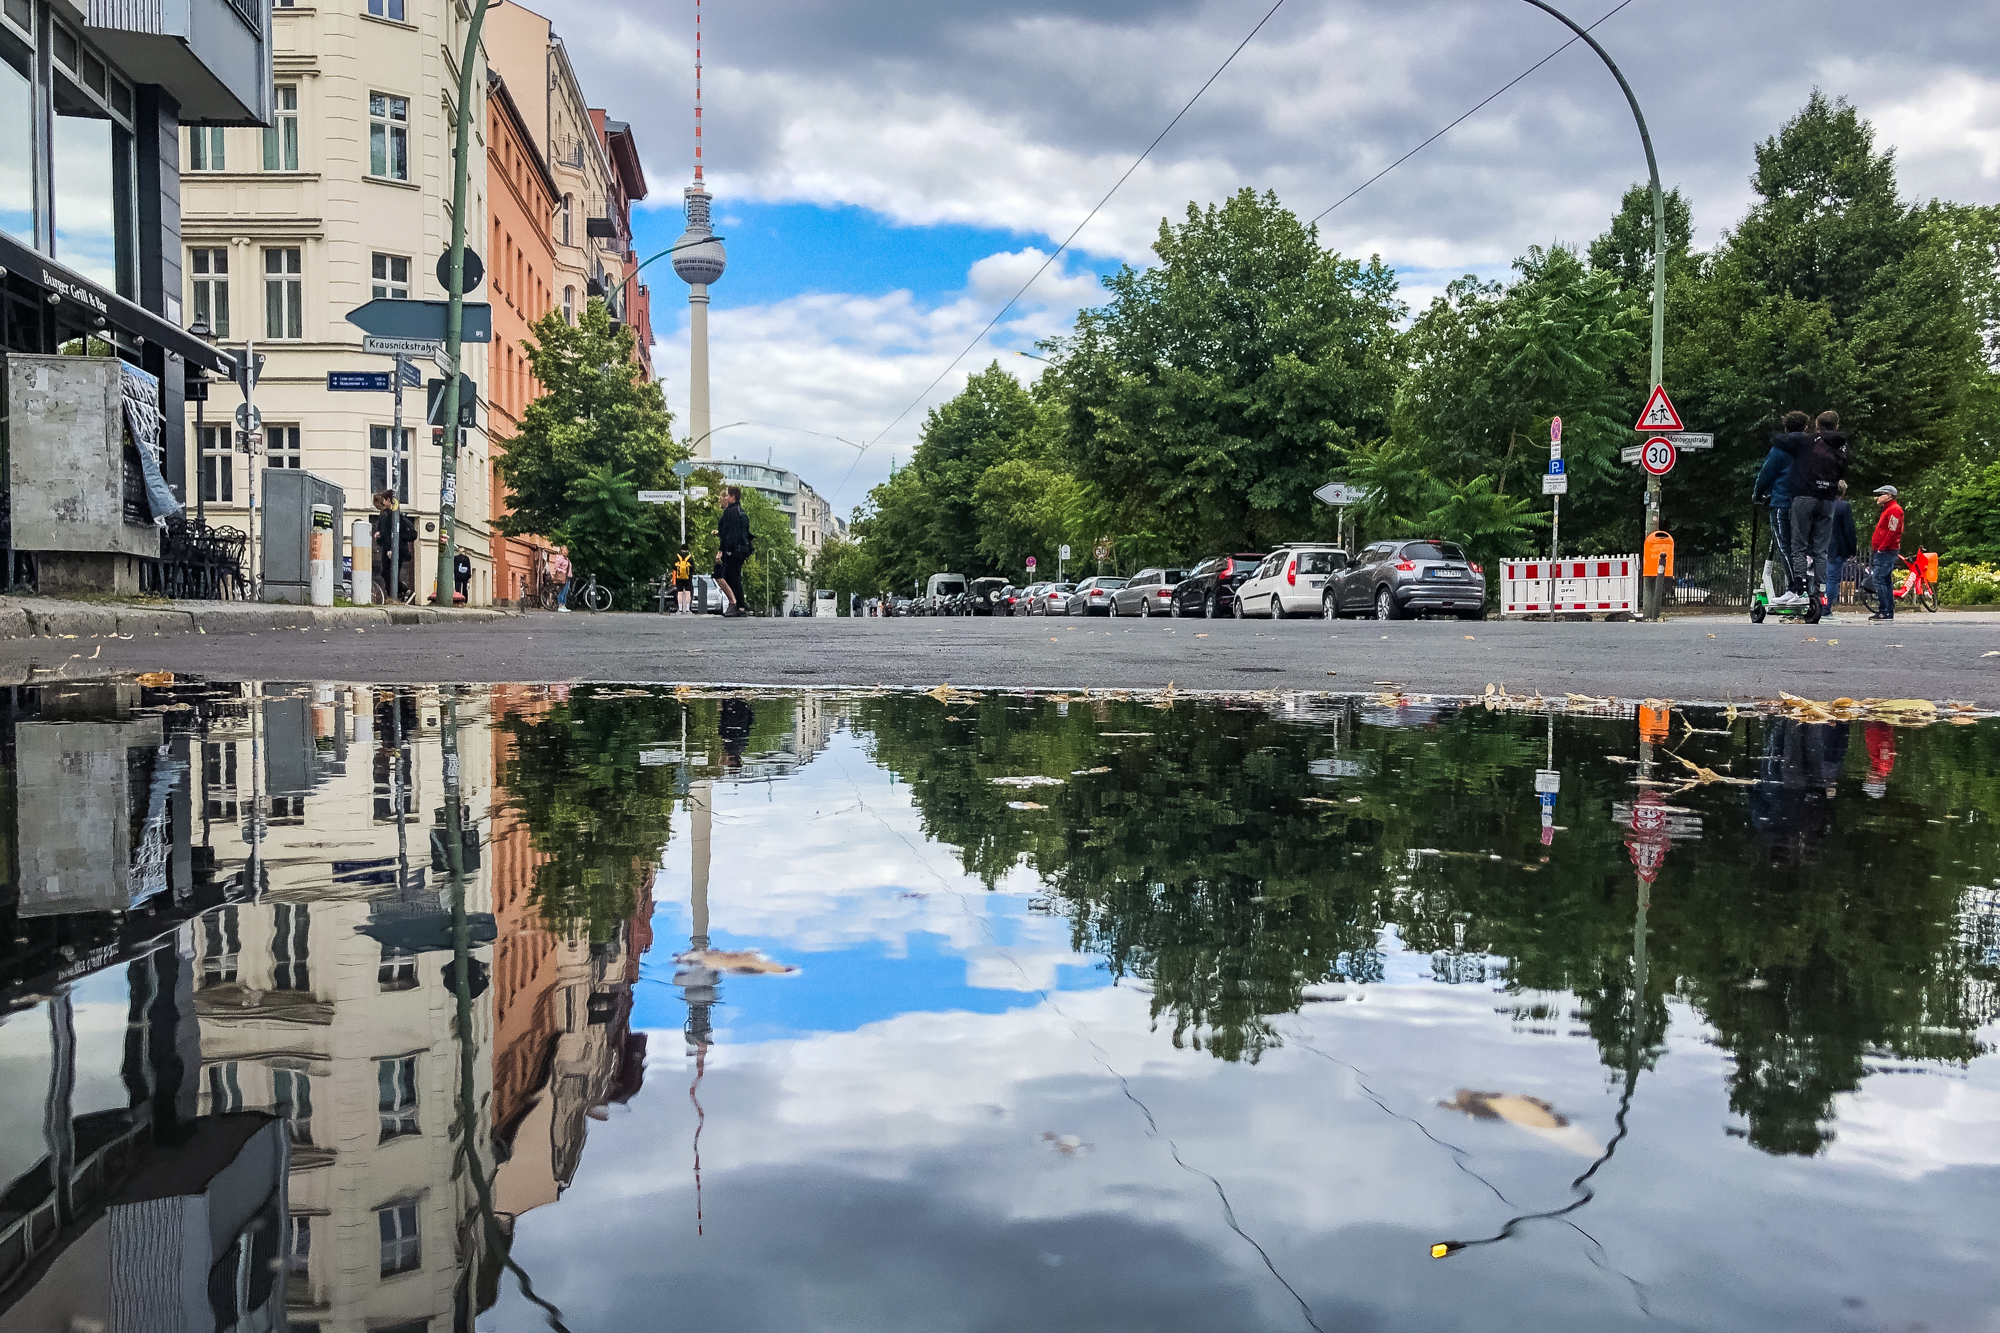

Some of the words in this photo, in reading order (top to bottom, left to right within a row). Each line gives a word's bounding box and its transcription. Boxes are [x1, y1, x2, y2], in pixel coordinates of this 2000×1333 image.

[42, 269, 69, 295] Burger
[70, 283, 89, 304] Grill
[88, 292, 96, 308] &
[94, 294, 108, 314] Bar
[369, 339, 436, 354] Krausnickstraße
[1648, 447, 1668, 464] 30
[1551, 461, 1560, 473] P
